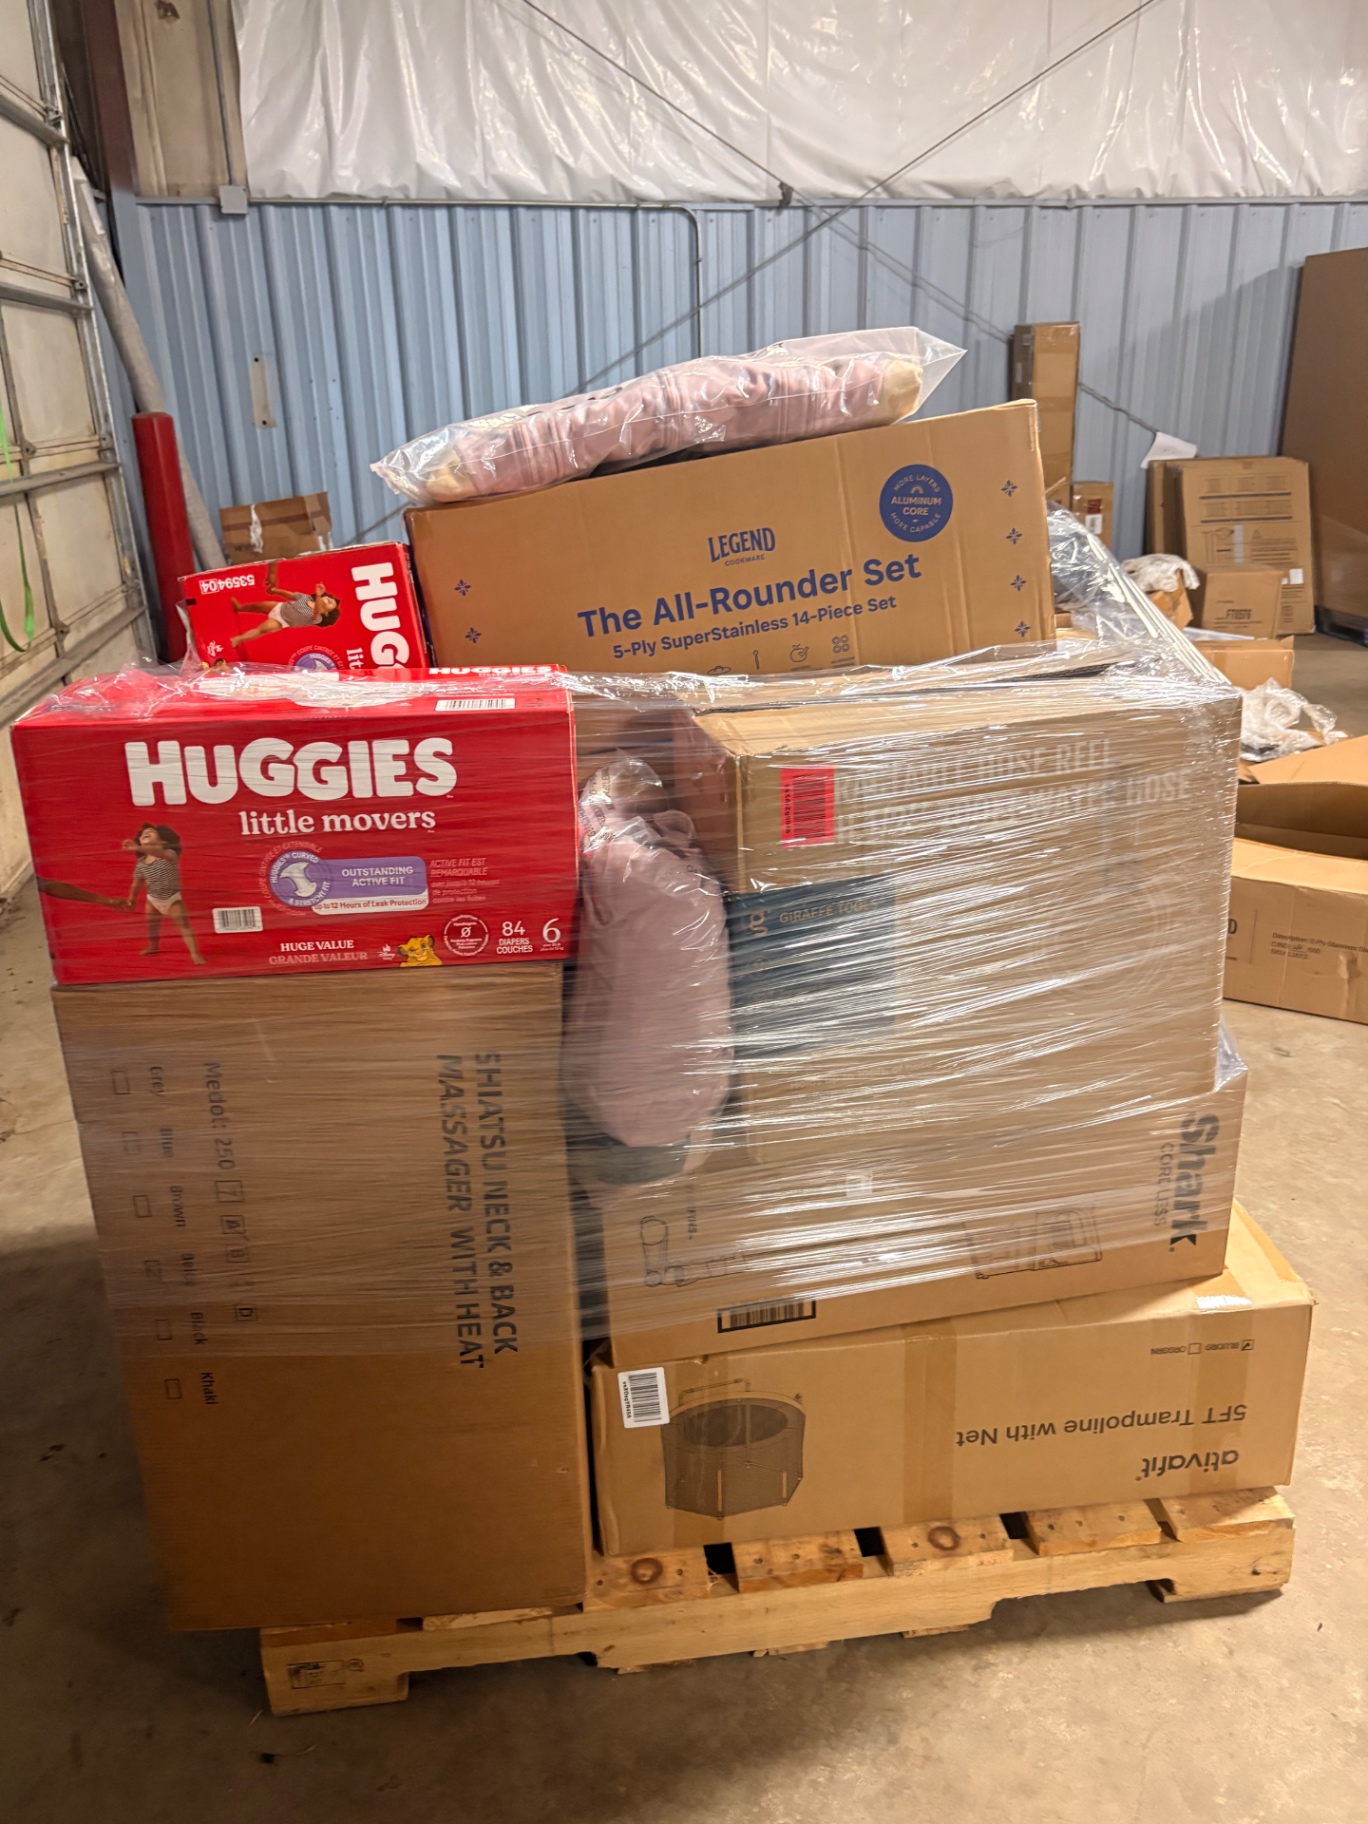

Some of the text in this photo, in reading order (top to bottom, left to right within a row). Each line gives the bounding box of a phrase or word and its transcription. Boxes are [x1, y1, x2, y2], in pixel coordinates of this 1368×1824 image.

[891, 496, 942, 506] ALUMINUM
[902, 507, 929, 516] CORE
[890, 512, 941, 532] MORE CAPABLE
[707, 526, 776, 563] LEGEND
[724, 554, 765, 567] COOKWARE
[218, 574, 255, 590] 53594
[577, 553, 922, 638] The All-Rounder Set
[351, 562, 410, 669] HUG
[612, 595, 897, 659] 5-Ply SuperStainless 14-Piece Set
[428, 666, 552, 675] HUGGIES
[124, 737, 458, 807] HUGGIES
[1128, 768, 1189, 807] HOSE
[239, 810, 436, 835] little movers
[291, 852, 319, 863] CURVED
[341, 866, 414, 877] OUTSTANDING
[352, 876, 405, 887] ACTIVE FIT
[339, 901, 360, 909] Hours
[360, 900, 370, 908] of
[389, 898, 426, 907] Protection
[498, 937, 529, 946] DIAPERS
[501, 918, 561, 943] 84 6
[269, 951, 368, 965] GRANDE VALEUR
[280, 939, 354, 952] HUGE VALUE
[496, 945, 533, 954] COUCHES
[215, 1138, 235, 1170] 250
[1170, 1112, 1221, 1247] Shark
[437, 1054, 485, 1369] MASSAGER WITH HEAT
[474, 1051, 518, 1354] SHIATSU NECK & BACK
[169, 1185, 187, 1228] Brown
[201, 1372, 219, 1405] Khaki
[956, 1404, 1247, 1447] 5FT Trampoline with Net
[1141, 1450, 1239, 1479] ativafit
